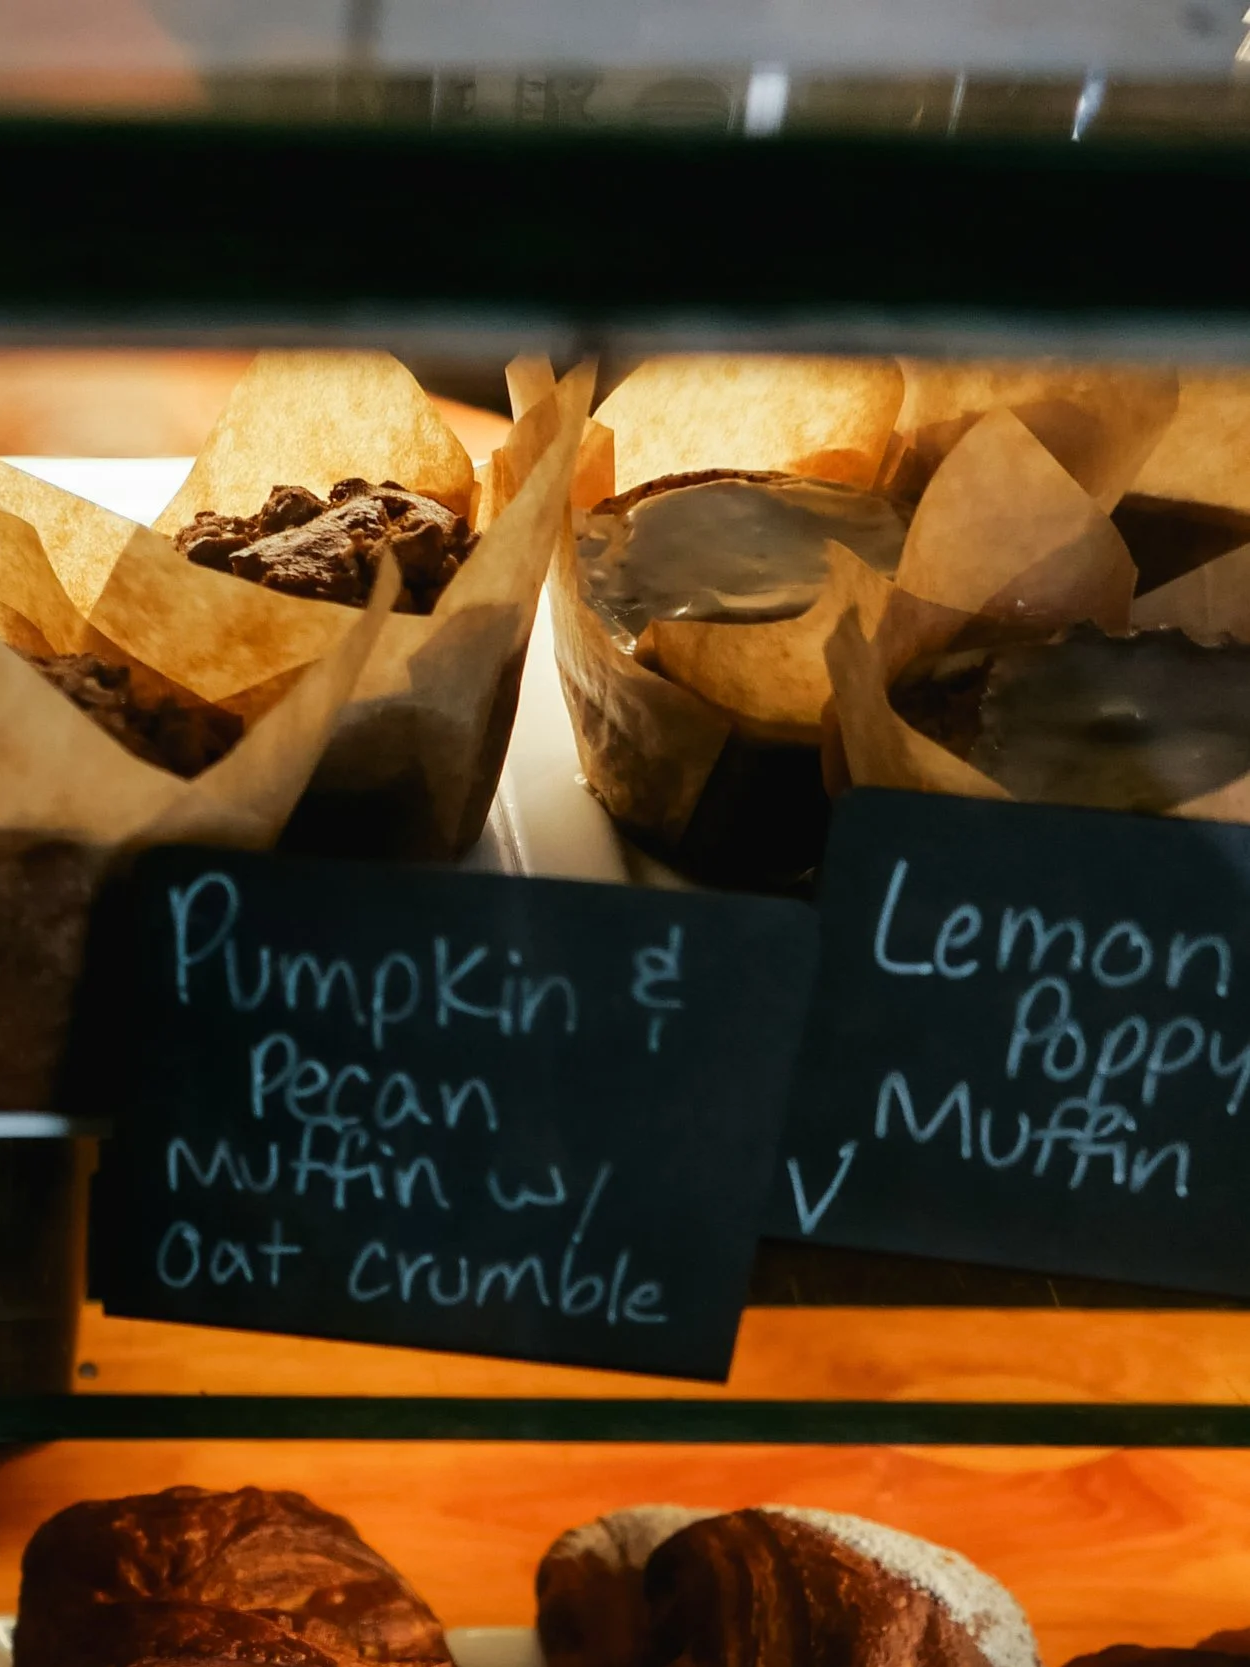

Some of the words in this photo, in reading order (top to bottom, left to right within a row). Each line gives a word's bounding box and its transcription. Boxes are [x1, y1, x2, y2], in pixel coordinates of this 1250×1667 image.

[873, 857, 1232, 999] Lemon
[251, 1032, 498, 1132] Pecan
[1006, 975, 1250, 1116] Poppy
[166, 1117, 450, 1210] Muffin
[874, 1069, 1191, 1198] Muffin
[786, 1140, 859, 1236] V
[156, 1220, 303, 1287] Oat
[350, 1238, 668, 1326] crumble
